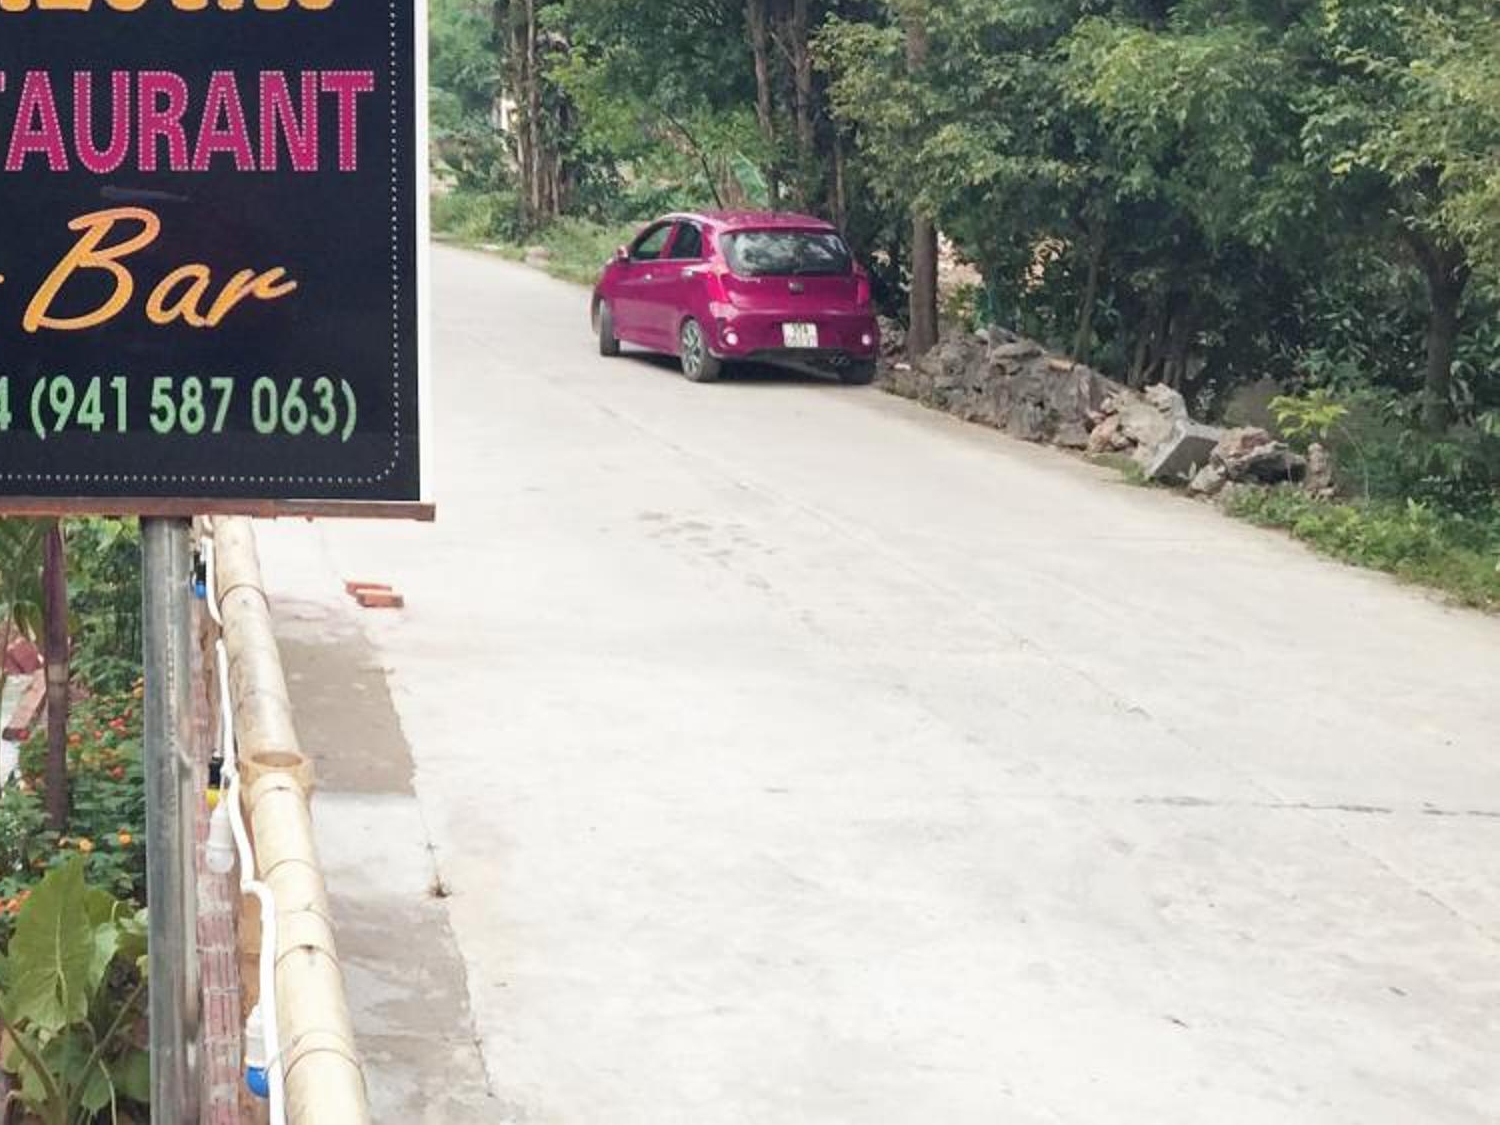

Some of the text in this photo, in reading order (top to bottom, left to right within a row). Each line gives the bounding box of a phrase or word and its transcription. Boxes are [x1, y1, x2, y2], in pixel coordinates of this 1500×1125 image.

[22, 206, 297, 333] Bar
[30, 375, 127, 440] (941
[149, 376, 234, 434] 587
[251, 376, 357, 443] 063)
